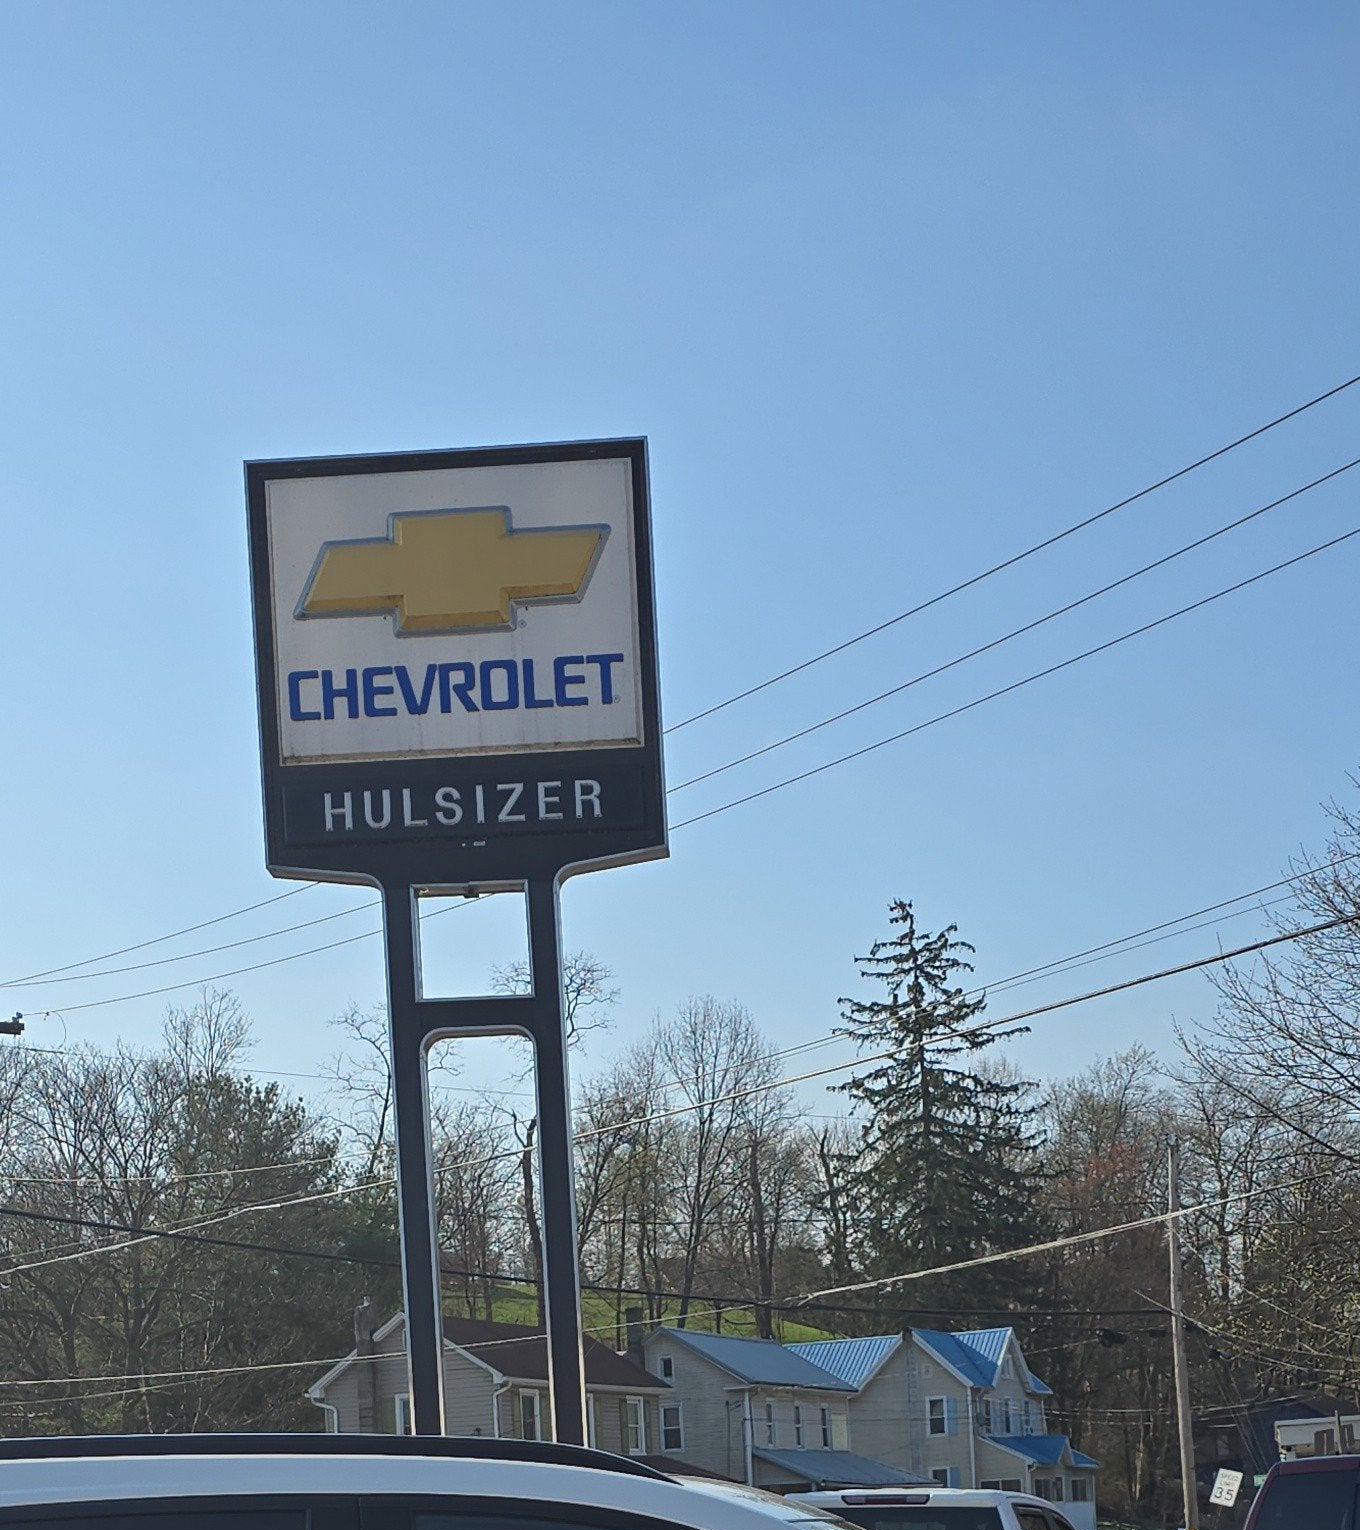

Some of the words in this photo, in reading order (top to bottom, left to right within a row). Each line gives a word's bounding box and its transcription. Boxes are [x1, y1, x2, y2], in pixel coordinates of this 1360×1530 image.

[288, 653, 624, 721] CHEVROLET
[324, 779, 603, 832] HULSIZER
[1214, 1486, 1235, 1501] 35
